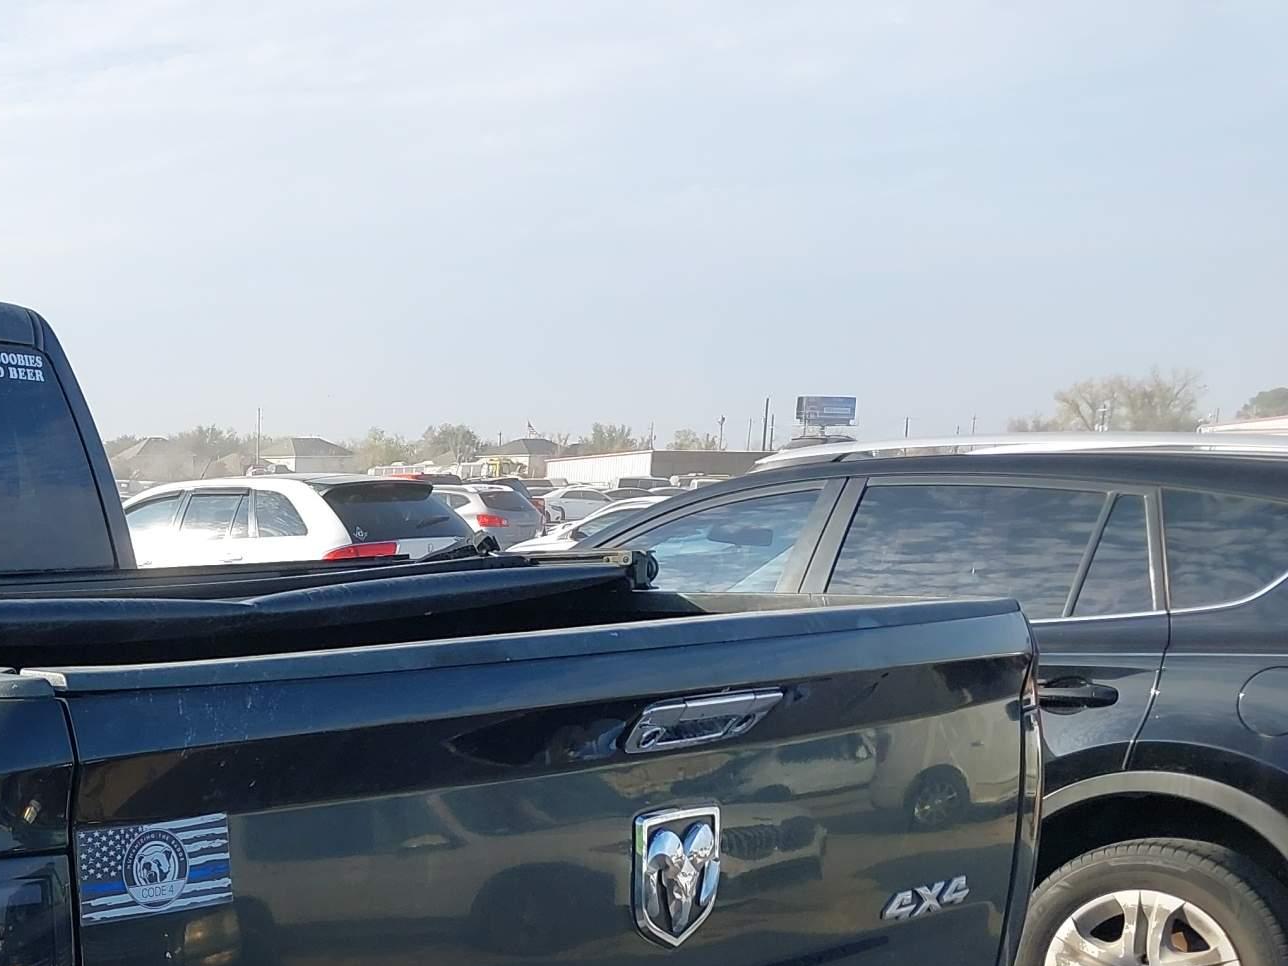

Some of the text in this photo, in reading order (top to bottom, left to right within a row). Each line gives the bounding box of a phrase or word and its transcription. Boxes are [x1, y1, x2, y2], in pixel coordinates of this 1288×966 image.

[8, 366, 44, 382] BEER
[141, 884, 175, 899] CODE 4
[884, 875, 970, 920] 4X4
